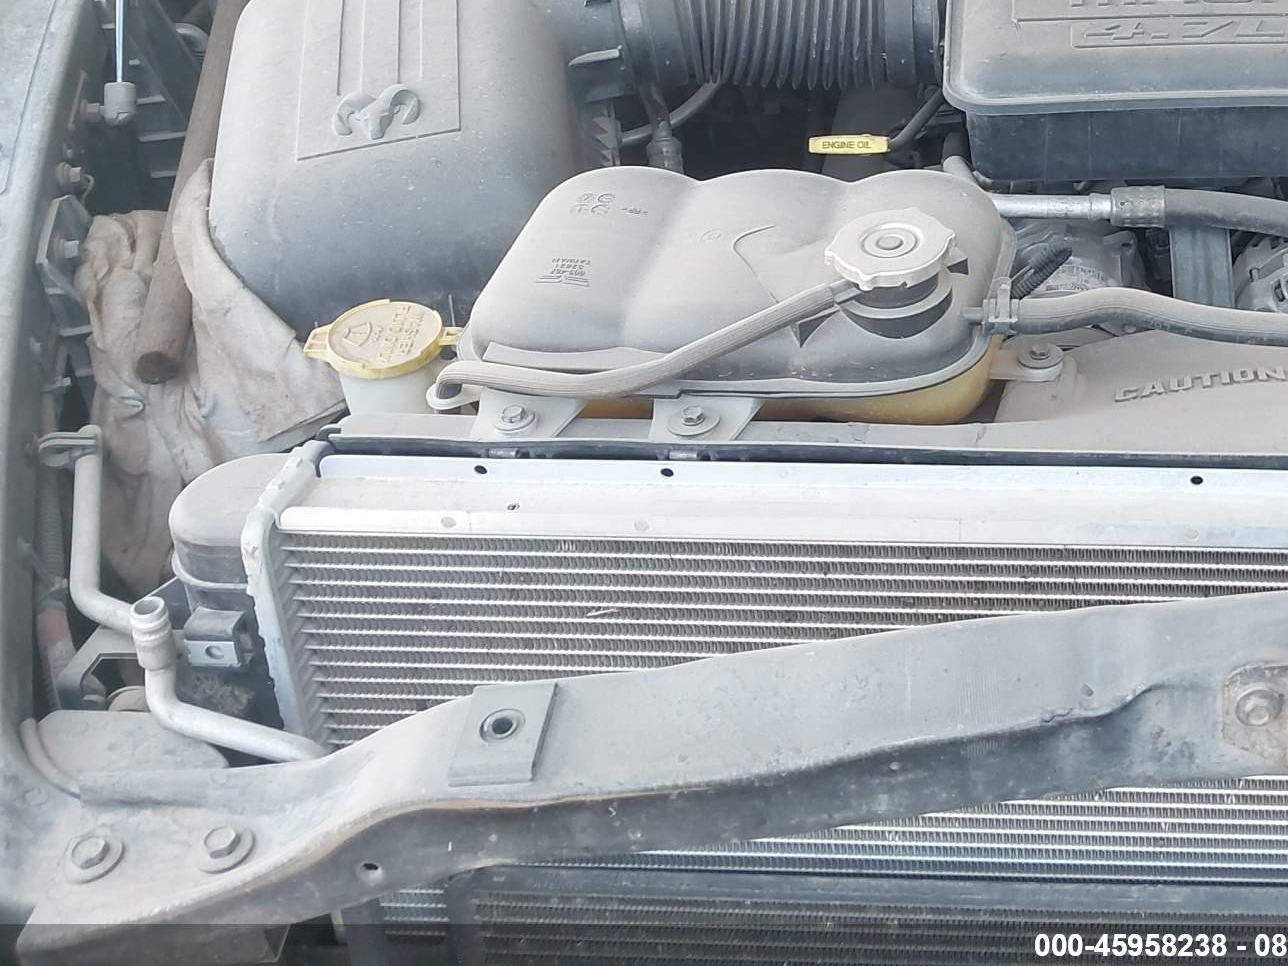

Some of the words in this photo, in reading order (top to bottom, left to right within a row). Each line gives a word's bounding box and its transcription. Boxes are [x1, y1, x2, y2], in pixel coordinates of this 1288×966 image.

[1083, 18, 1287, 41] 4.7L
[821, 140, 856, 150] ENGINE
[856, 140, 873, 149] OIL
[1113, 366, 1287, 403] CAUTION
